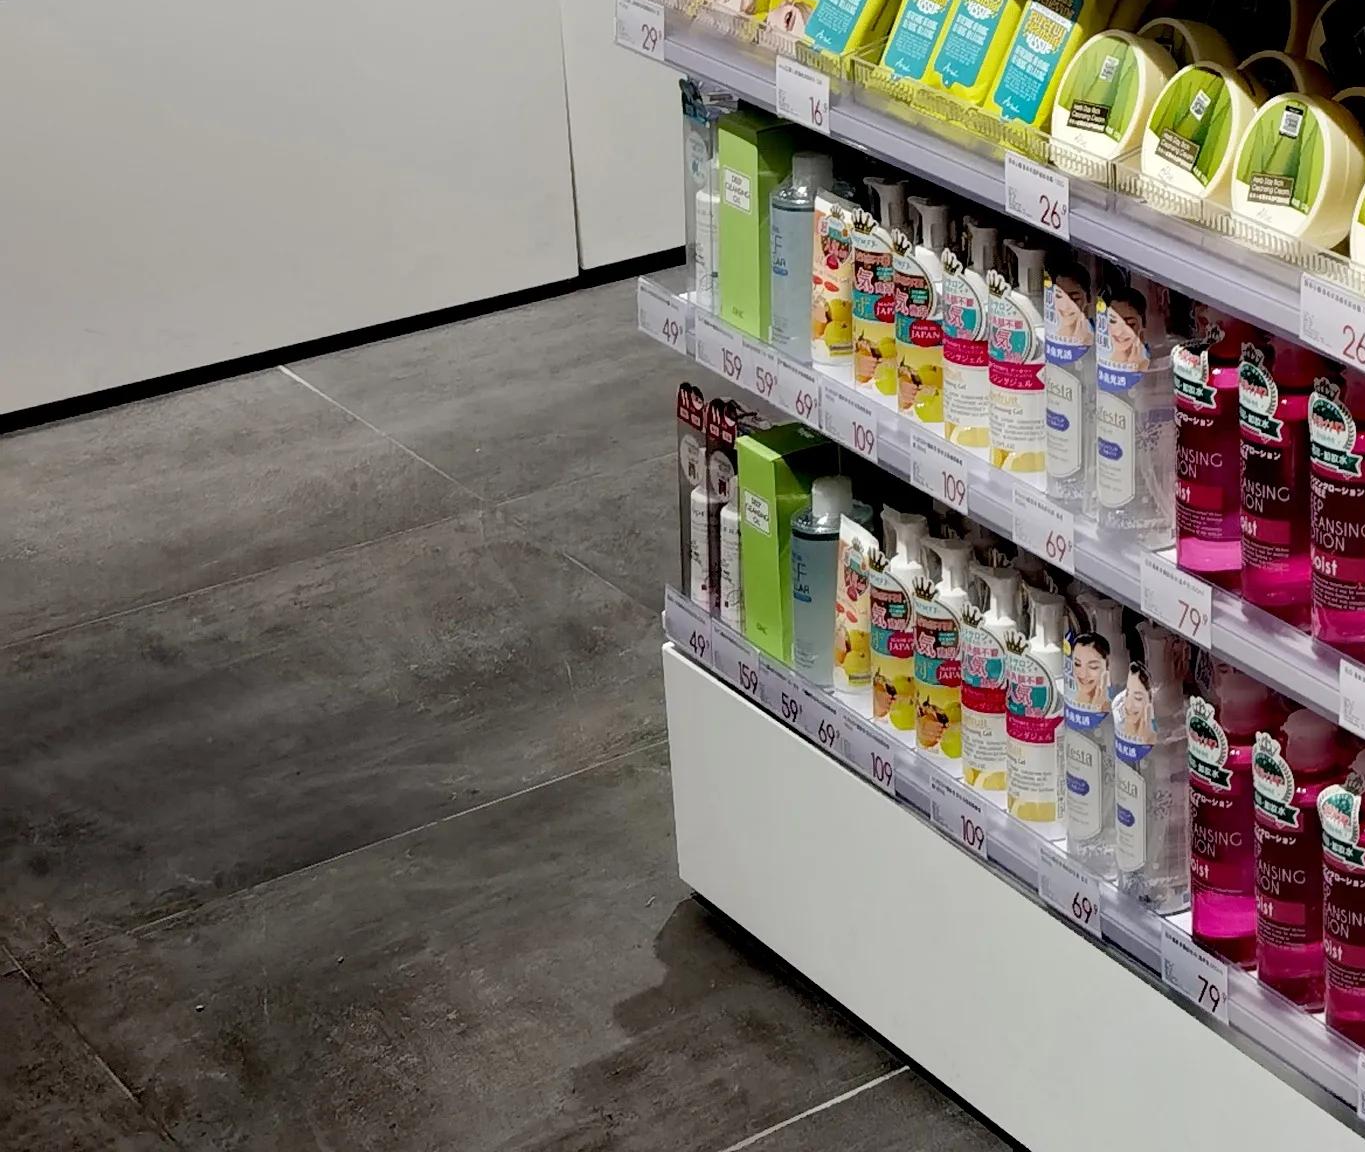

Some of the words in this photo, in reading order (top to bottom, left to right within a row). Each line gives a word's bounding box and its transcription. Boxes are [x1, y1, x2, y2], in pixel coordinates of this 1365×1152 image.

[720, 352, 742, 382] 159
[850, 423, 874, 454] 109
[942, 472, 965, 501] 109
[737, 662, 758, 694] 159
[870, 752, 892, 787] 109
[959, 817, 984, 851] 109
